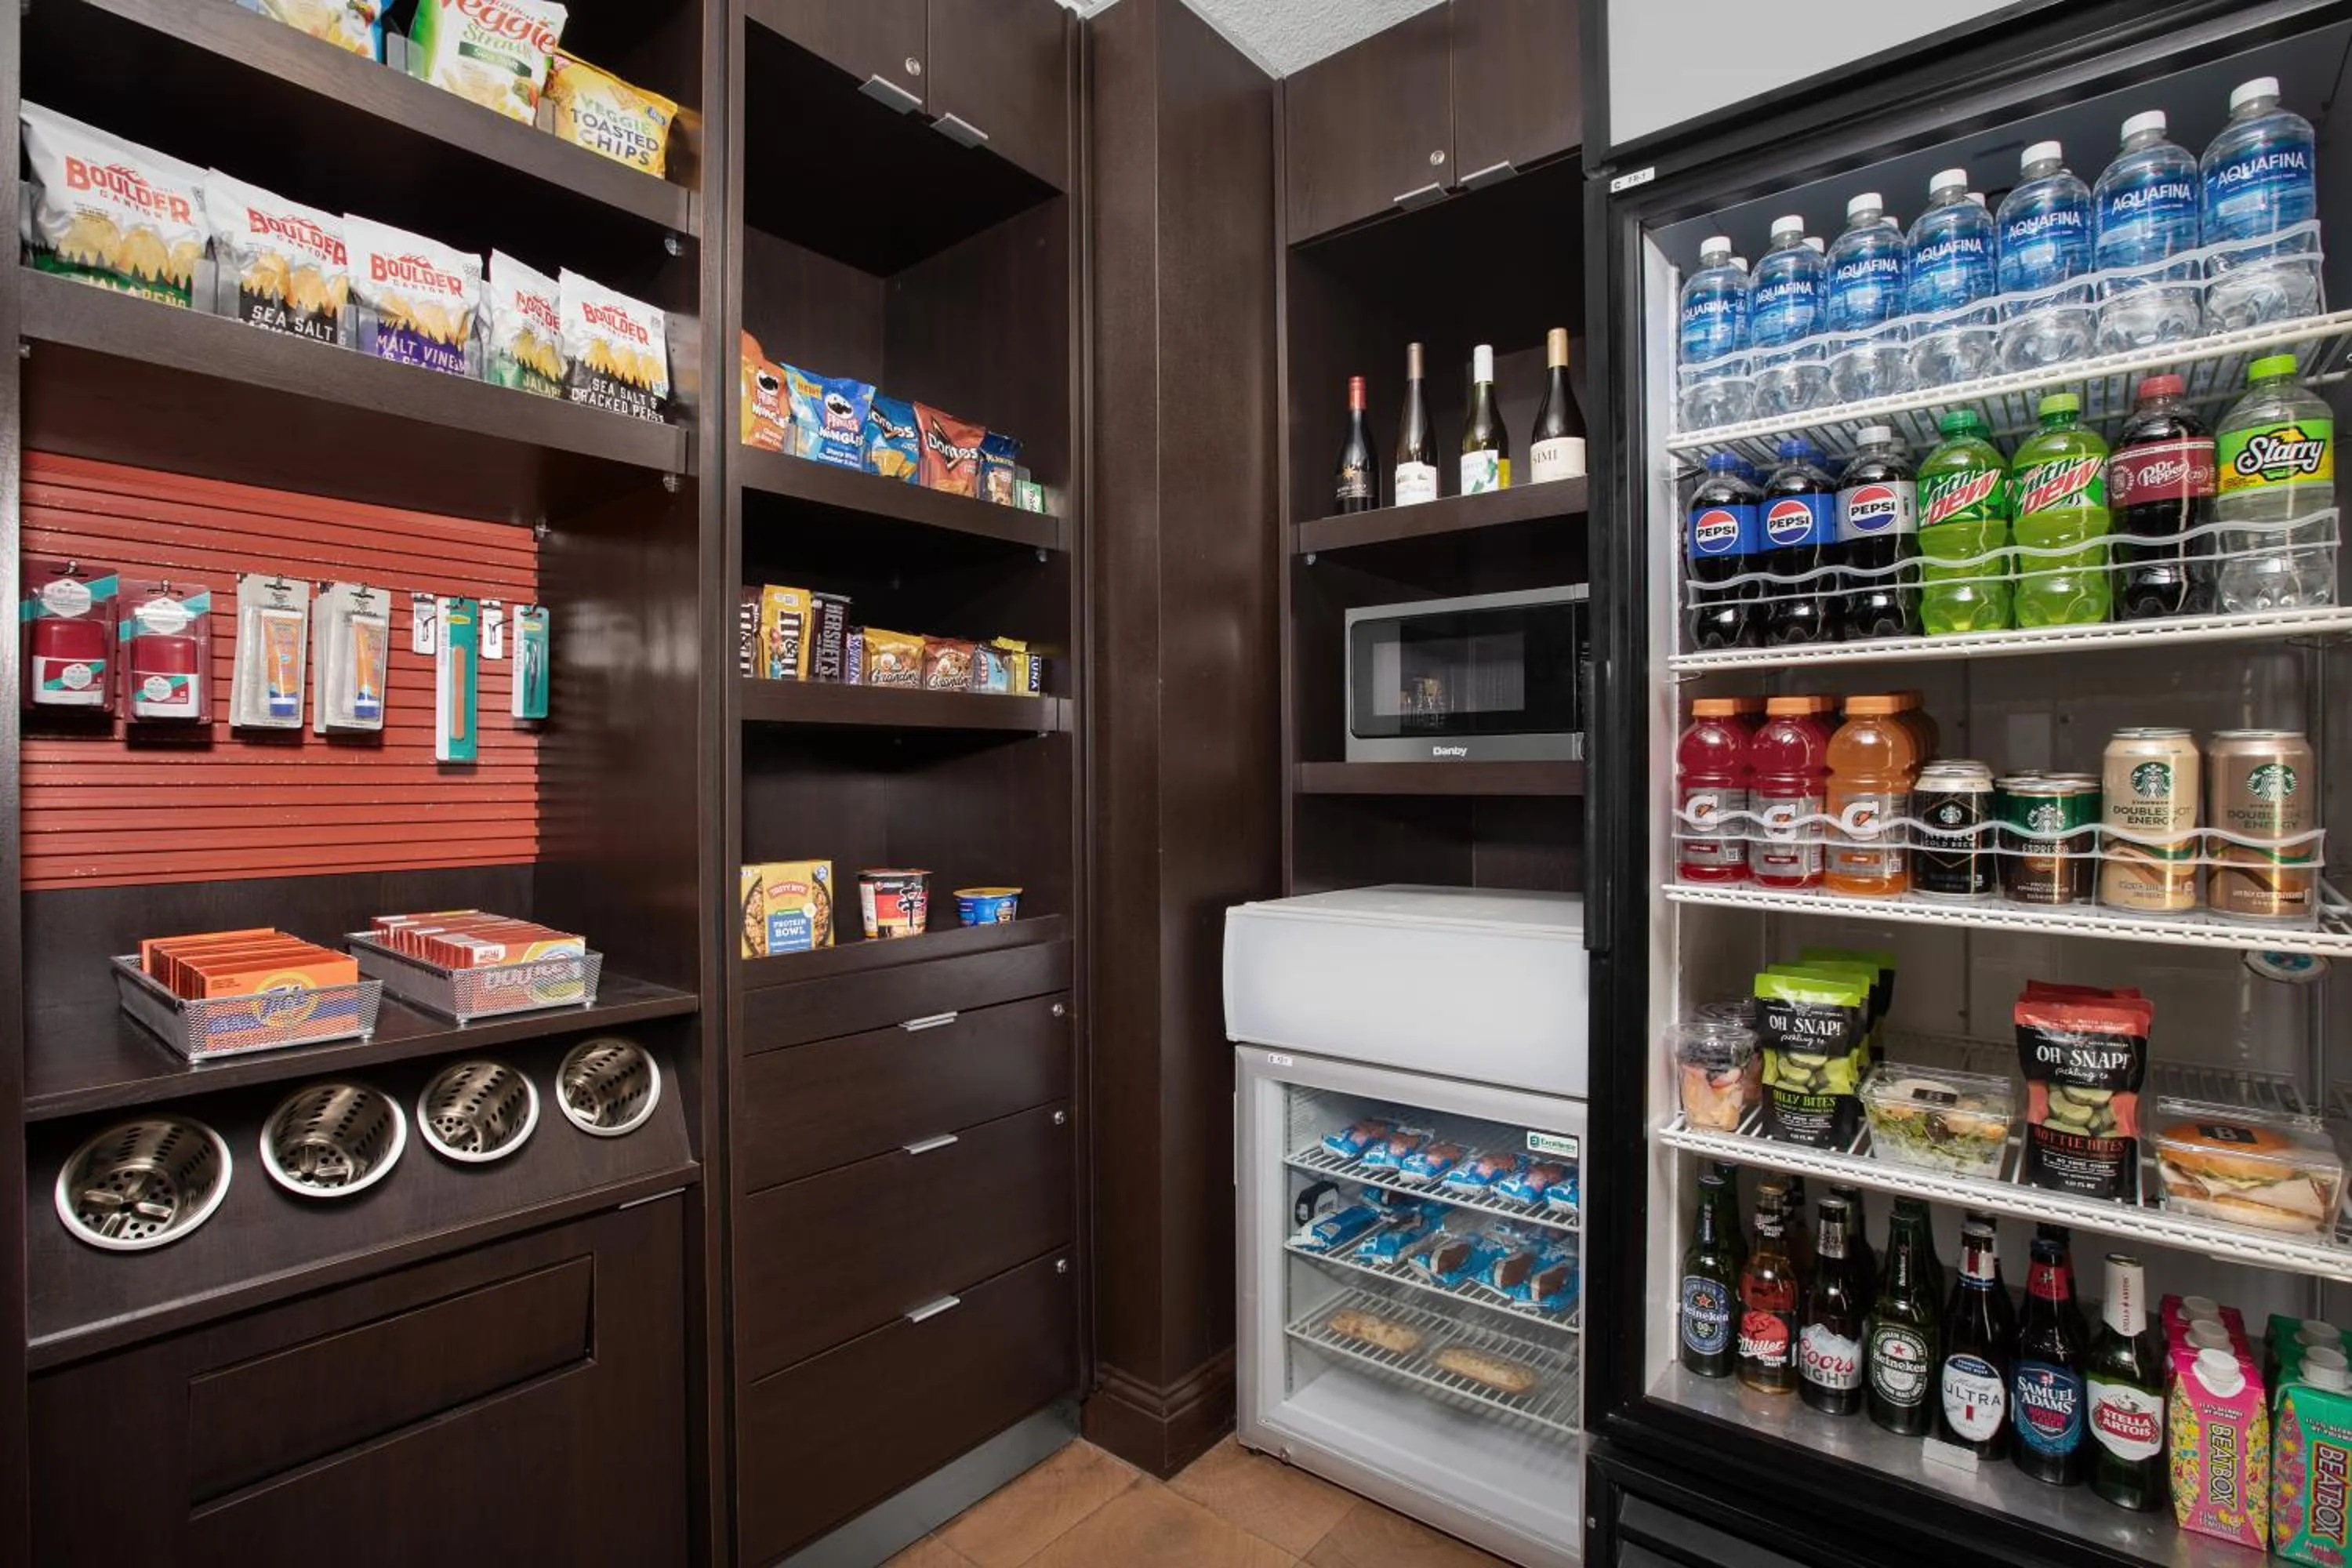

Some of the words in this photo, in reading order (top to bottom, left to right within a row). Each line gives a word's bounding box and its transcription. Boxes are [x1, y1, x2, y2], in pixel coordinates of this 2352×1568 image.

[441, 0, 557, 54] eggie
[580, 91, 654, 136] VEGGIE
[570, 107, 659, 152] TOASTED
[579, 129, 650, 165] CHIPS
[2217, 152, 2308, 188] AQUAFINA
[66, 156, 191, 224] BOULDER
[2111, 183, 2193, 215] AQUAFINA
[247, 207, 348, 266] BOULDER
[2008, 211, 2081, 239] AQUAFINA
[1916, 238, 1983, 266] AQUAFINA
[371, 253, 464, 298] BOULDER
[1835, 258, 1900, 284] AQUAFINA
[1755, 281, 1815, 305] AQUAFINA
[252, 305, 287, 328] SEA
[294, 317, 333, 341] SALT
[582, 301, 650, 345] BOULDER
[1682, 300, 1731, 321] QUAFINA
[376, 335, 417, 355] MALT
[571, 388, 628, 413] CRACKED
[592, 378, 615, 397] SEA
[620, 388, 646, 407] SALT
[928, 432, 978, 460] Doritos
[2236, 436, 2325, 474] Starry
[2140, 458, 2188, 486] Pepper
[2155, 459, 2172, 472] Dr
[1769, 514, 1810, 530] PEPSI
[1850, 502, 1895, 517] PEPSI
[1697, 524, 1736, 539] PEPSI
[1432, 746, 1468, 757] Danby
[2113, 806, 2194, 817] DOUBLESHOT
[2127, 815, 2177, 826] ENERGY
[775, 927, 807, 938] BOWL
[1769, 1014, 1787, 1031] OH
[1793, 1018, 1843, 1036] SNAP!
[2036, 1045, 2061, 1064] OH
[2069, 1049, 2132, 1070] SNAP!
[1738, 1334, 1785, 1352] Miller
[1800, 1337, 1854, 1372] Coors
[1873, 1351, 1927, 1373] Heineken
[1944, 1380, 2002, 1406] ULTRA
[2017, 1376, 2076, 1403] SAMUEL
[2021, 1392, 2072, 1415] ADAMS
[2103, 1408, 2151, 1427] STELLA
[2103, 1417, 2151, 1437] ARTOIS
[2210, 1423, 2234, 1508] BEATBOX
[2315, 1445, 2347, 1540] BEATBOX
